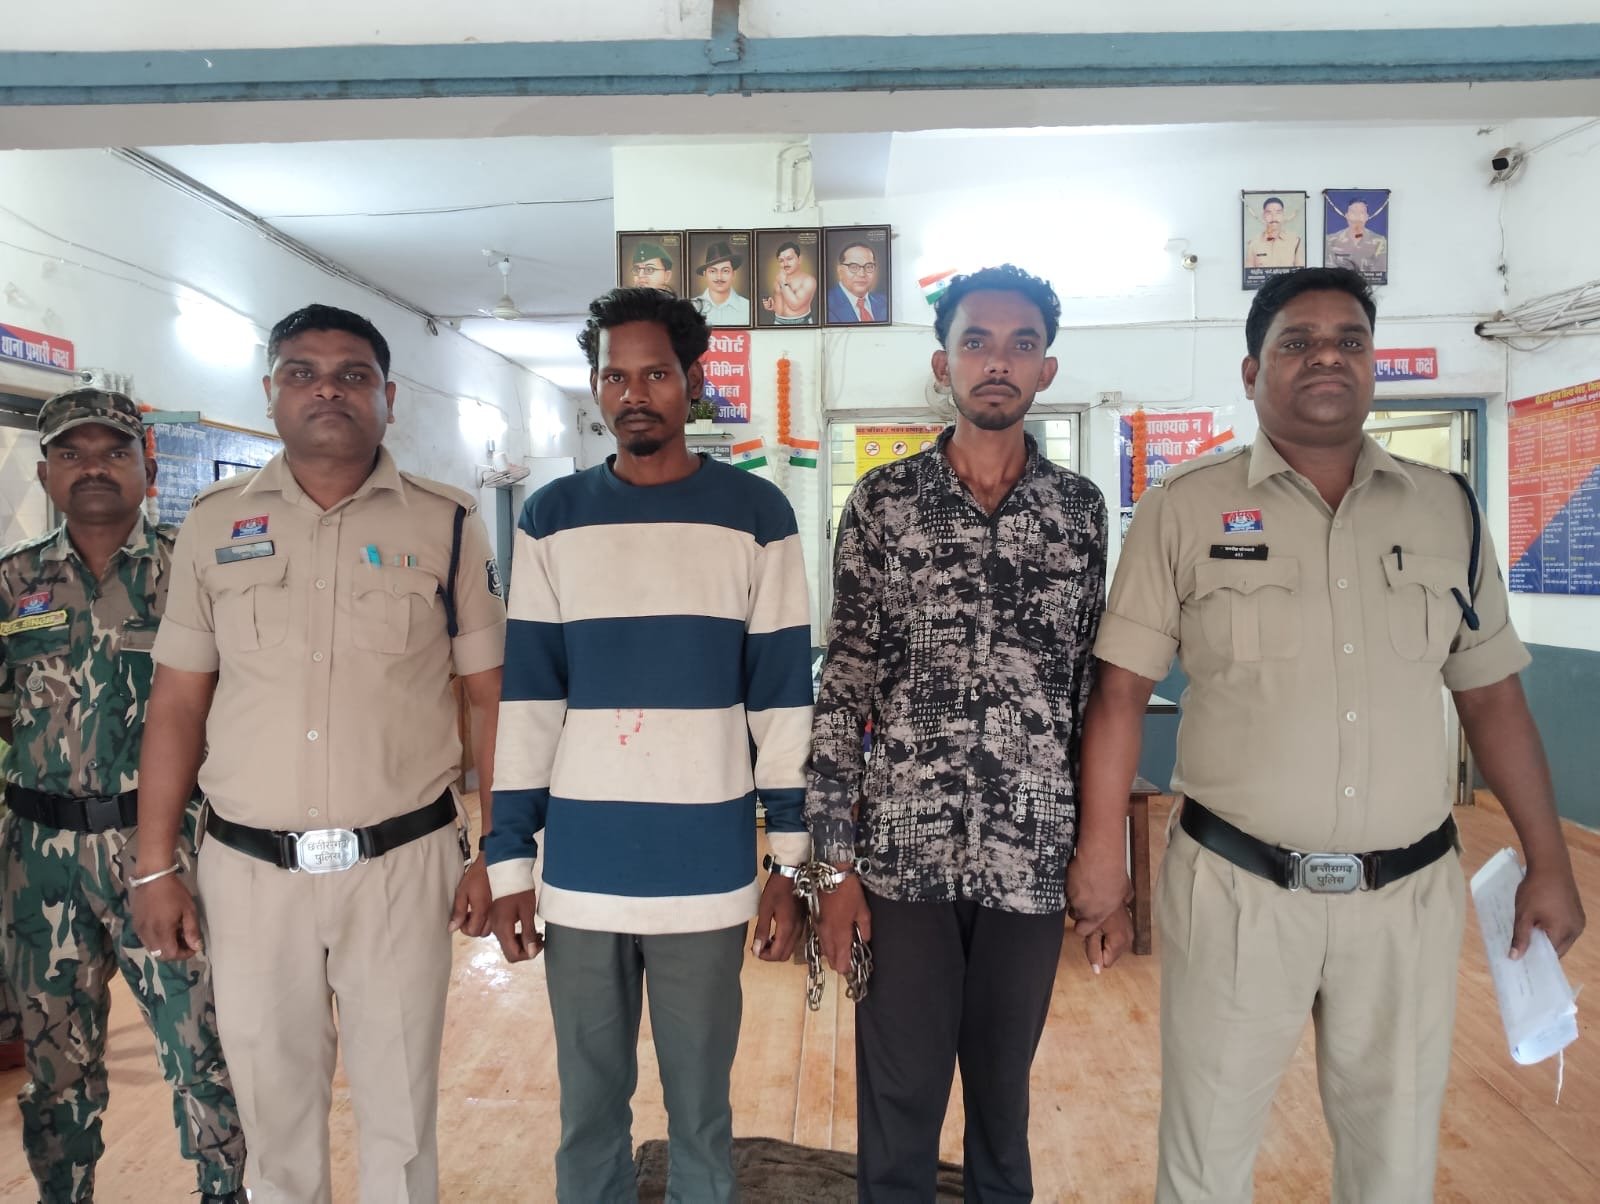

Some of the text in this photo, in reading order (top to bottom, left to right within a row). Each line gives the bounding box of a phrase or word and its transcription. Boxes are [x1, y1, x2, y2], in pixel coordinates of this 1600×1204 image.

[1, 335, 70, 369] थाना प्रभारी कक्ष
[710, 360, 745, 377] विभिन्न
[1415, 357, 1434, 374] कक्ष
[704, 381, 740, 398] के तहत
[718, 402, 748, 419] जावेगी
